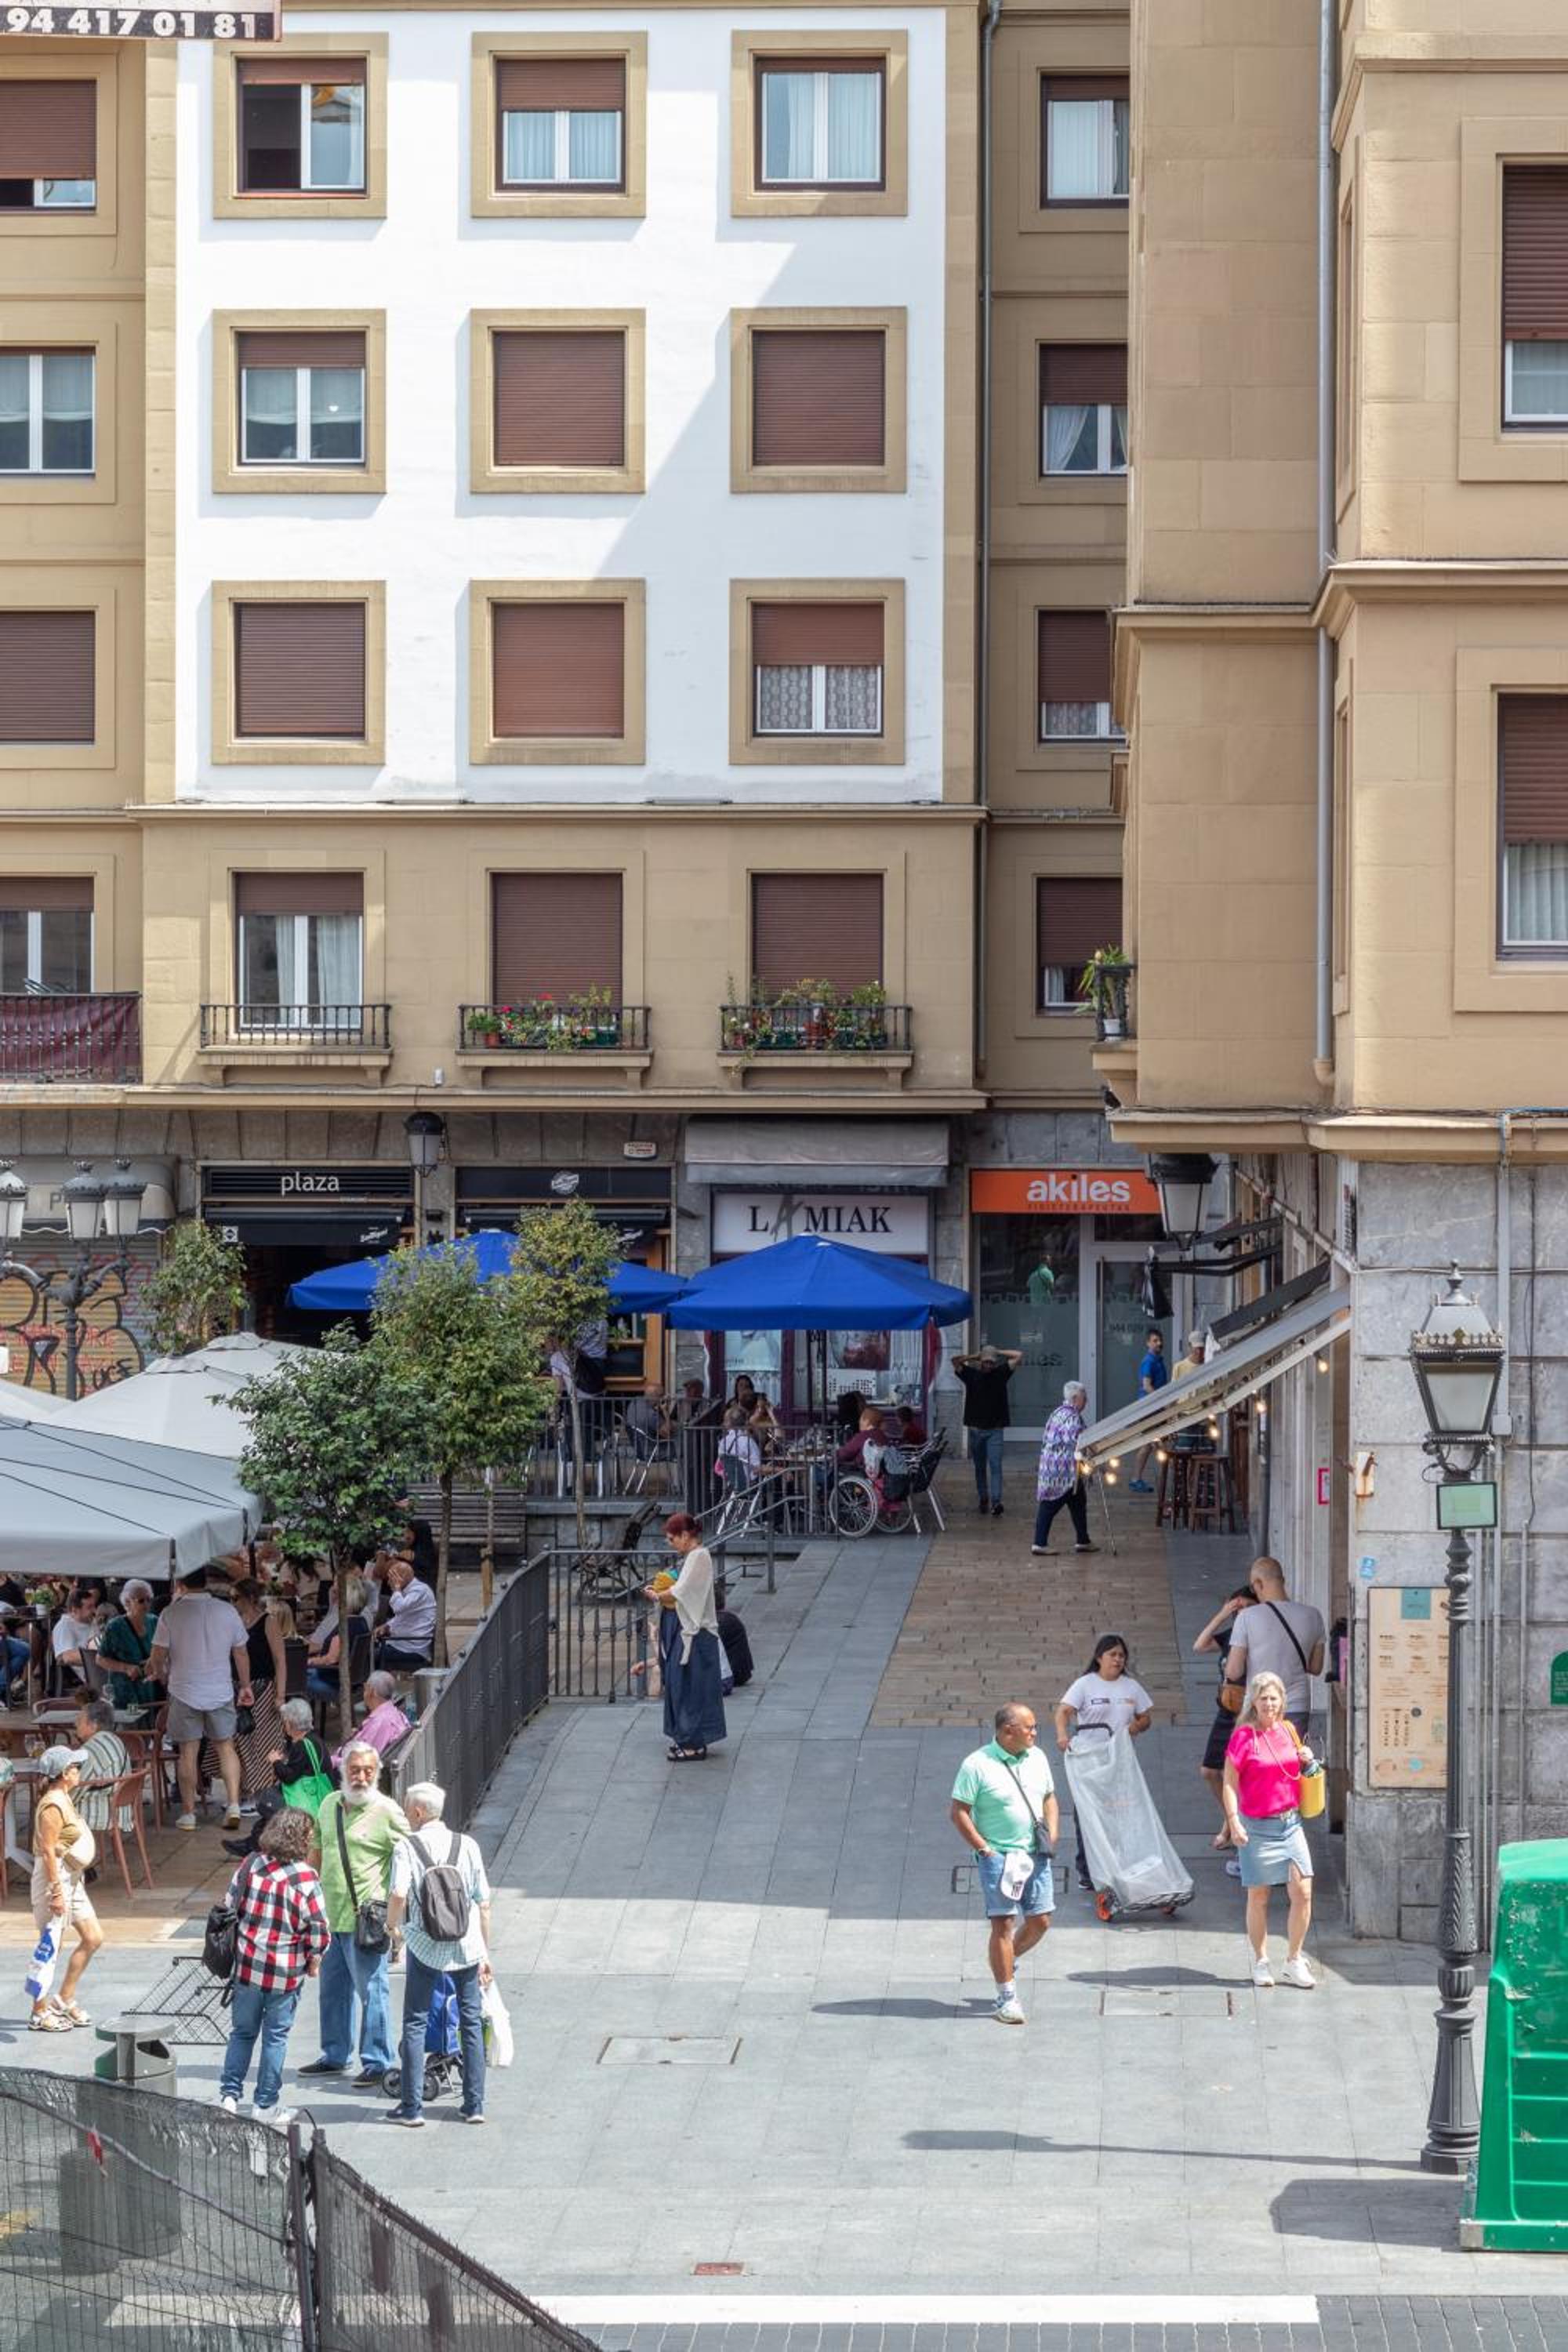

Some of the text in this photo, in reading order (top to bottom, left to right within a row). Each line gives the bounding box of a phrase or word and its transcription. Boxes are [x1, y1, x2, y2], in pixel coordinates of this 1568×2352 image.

[6, 8, 256, 38] 94 417 01 81
[281, 1171, 339, 1197] plaza
[1027, 1173, 1131, 1203] akiles
